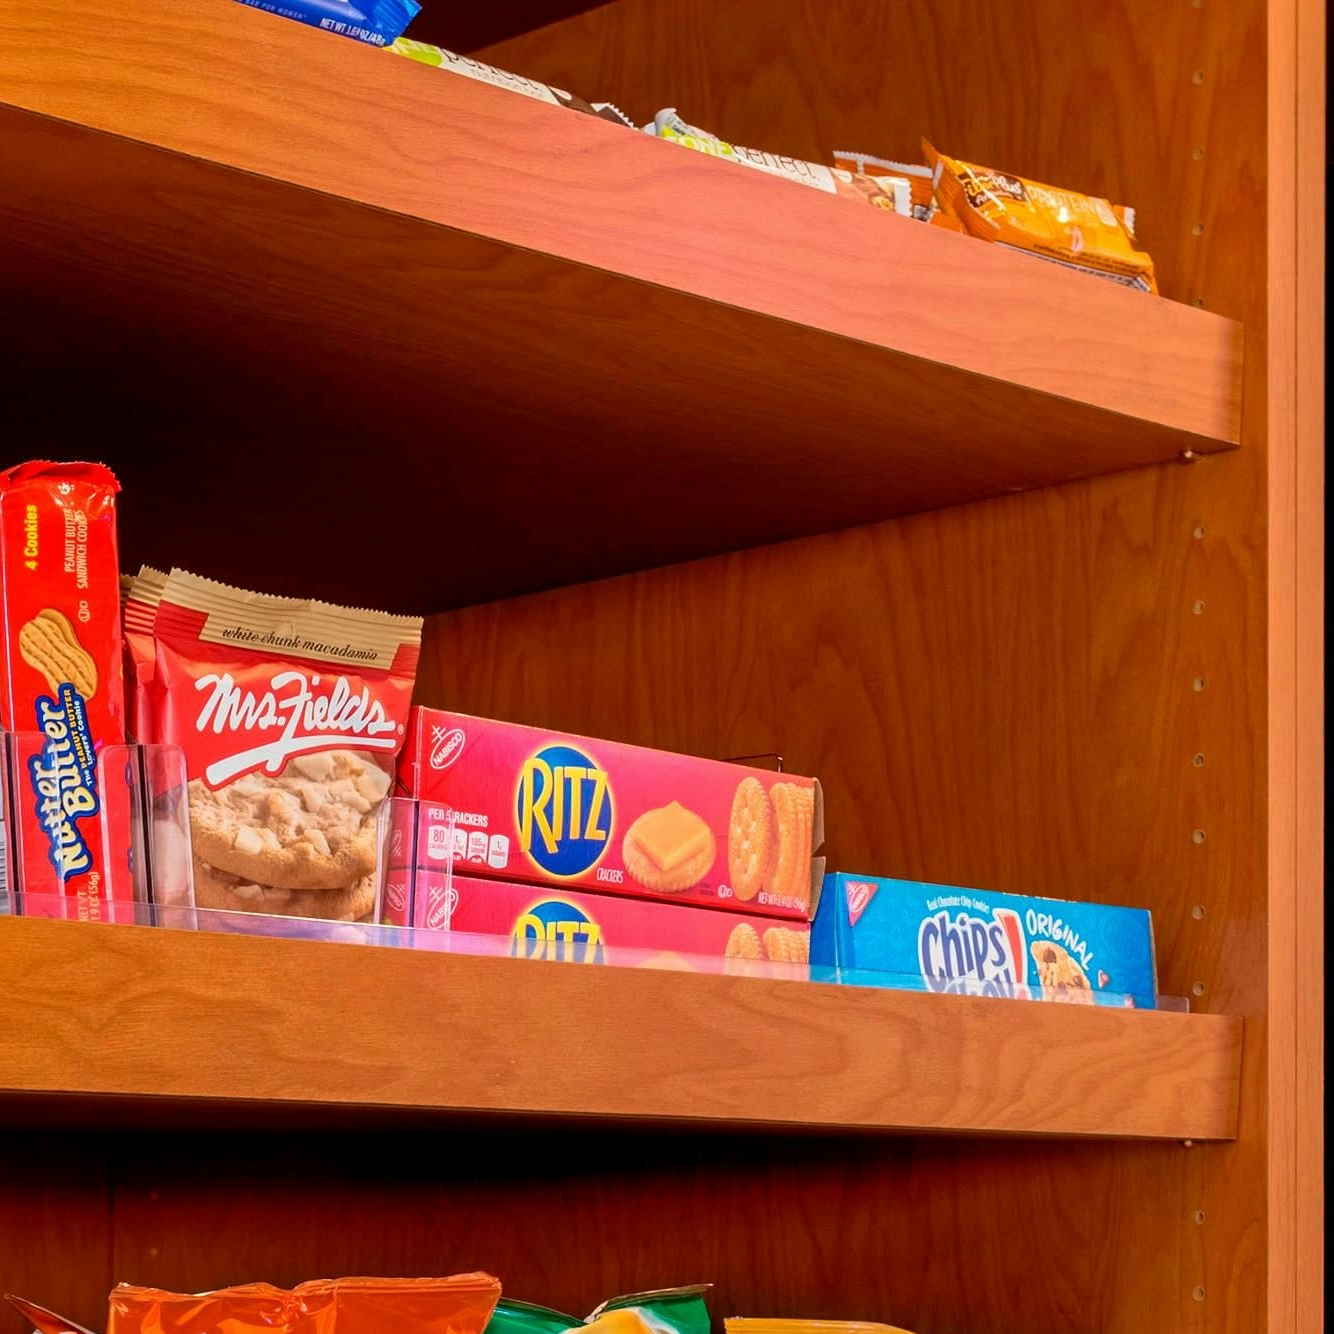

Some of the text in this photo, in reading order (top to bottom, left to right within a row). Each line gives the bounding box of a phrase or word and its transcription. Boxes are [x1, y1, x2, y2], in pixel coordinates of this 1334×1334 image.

[320, 18, 347, 32] NET WT
[23, 504, 39, 571] 4 Cookies
[64, 541, 77, 573] PEANUT
[76, 543, 89, 589] SANDWICH
[222, 626, 379, 661] white chunk macadamia
[271, 671, 396, 742] Fields
[39, 701, 97, 818] Butter
[63, 688, 94, 787] The PEANUT BUTTER
[431, 731, 464, 767] NABISCO
[32, 758, 90, 880] Nutter
[428, 808, 445, 820] PER
[520, 757, 609, 855] RITZ
[432, 830, 445, 844] 80
[596, 867, 624, 883] CRACKERS
[920, 912, 1005, 986] Chips
[1026, 907, 1095, 970] ORIGINAL
